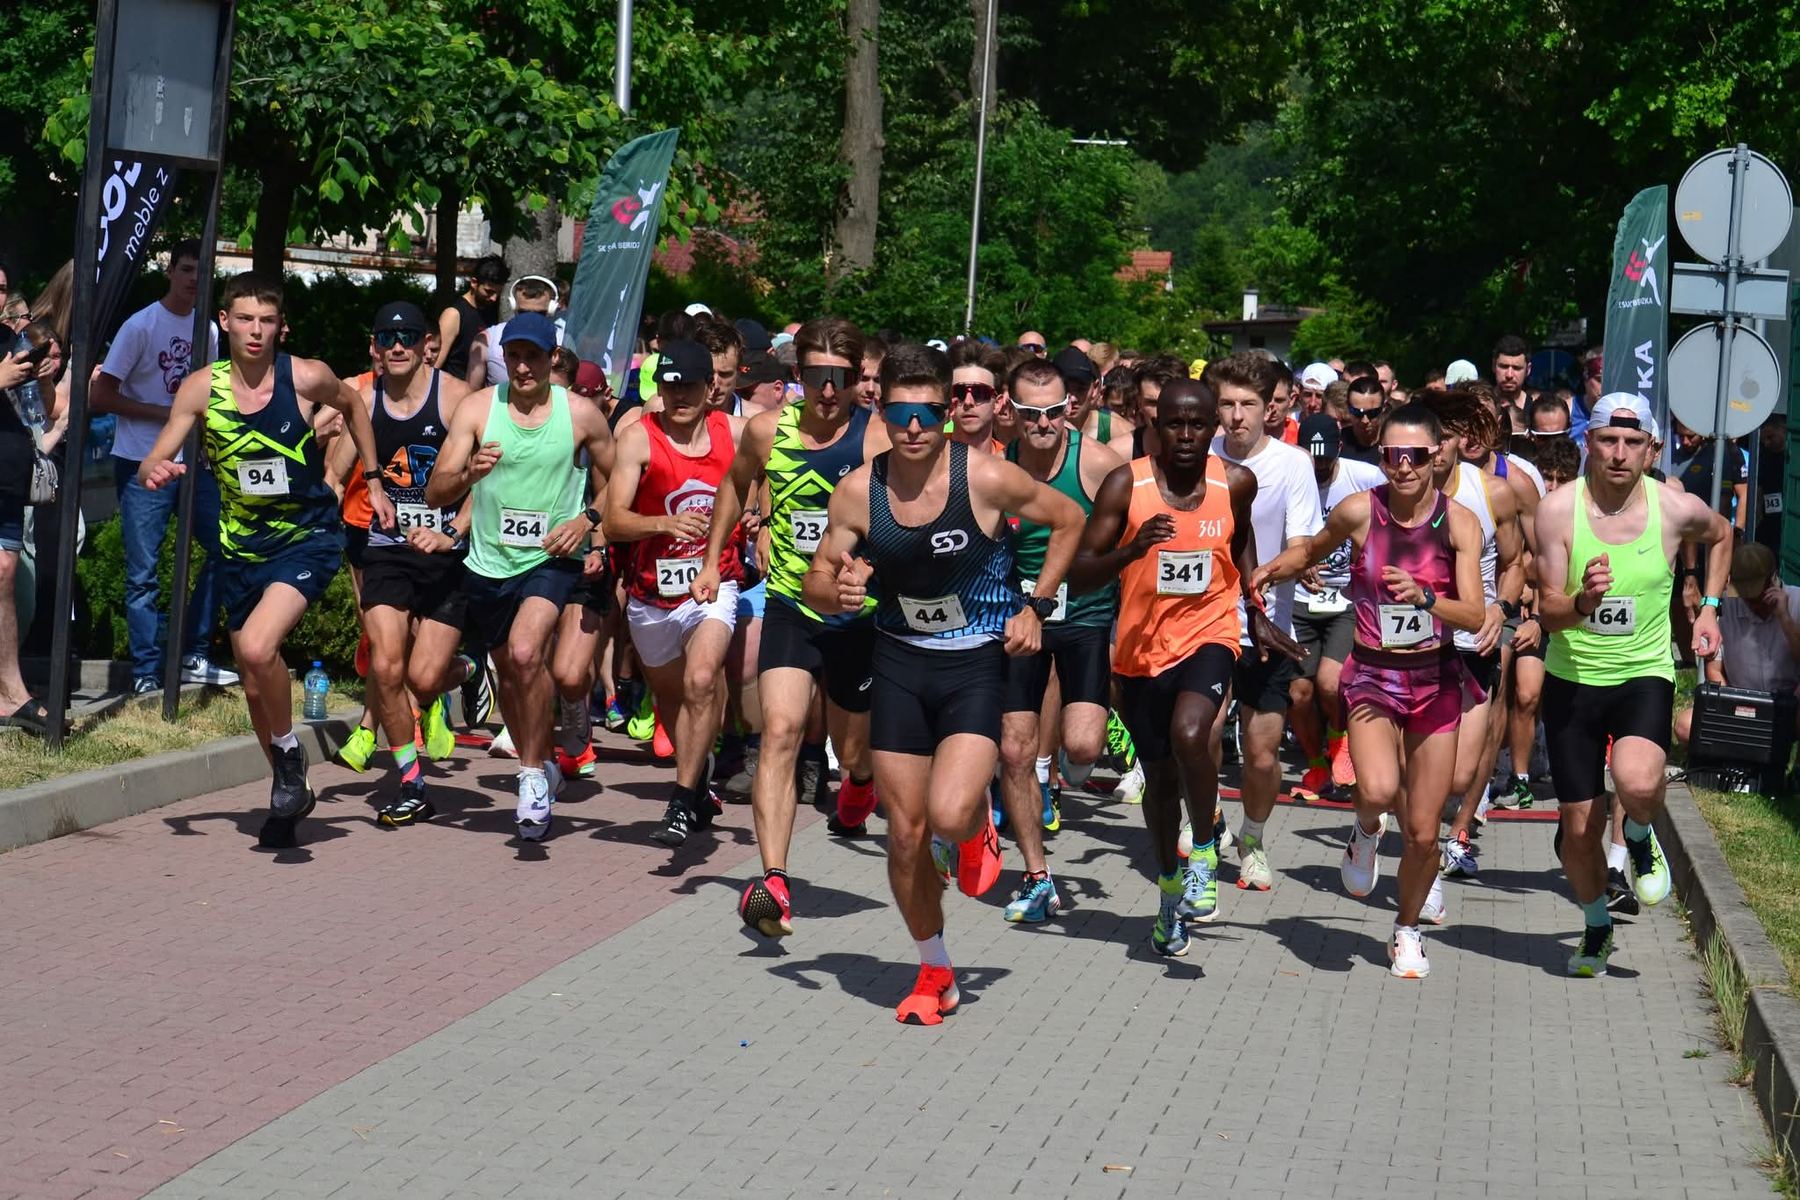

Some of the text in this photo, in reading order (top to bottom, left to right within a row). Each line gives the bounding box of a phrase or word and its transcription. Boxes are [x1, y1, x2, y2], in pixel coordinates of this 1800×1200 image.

[124, 187, 160, 261] meble
[248, 468, 276, 486] 94
[400, 512, 436, 529] 313
[503, 518, 542, 538] 264
[794, 521, 821, 541] 23
[660, 567, 699, 586] 210
[1160, 562, 1204, 583] 341
[1316, 590, 1338, 604] 34
[915, 607, 948, 624] 44
[1391, 615, 1422, 634] 74
[1590, 607, 1629, 626] 164
